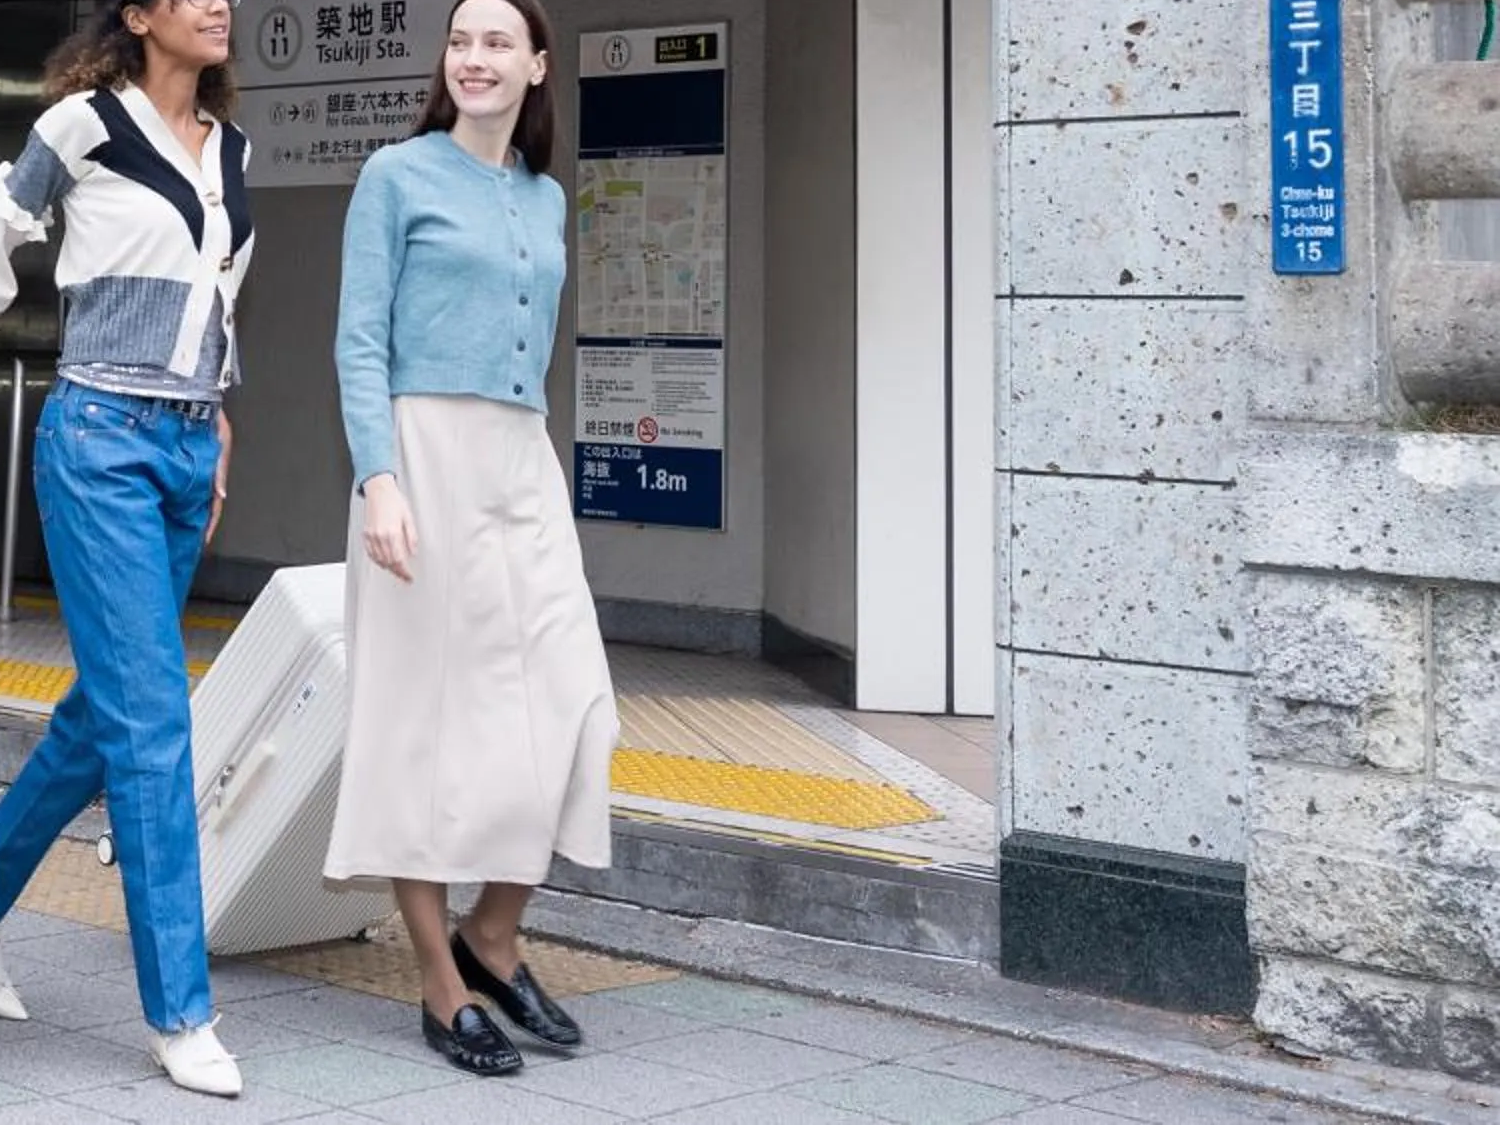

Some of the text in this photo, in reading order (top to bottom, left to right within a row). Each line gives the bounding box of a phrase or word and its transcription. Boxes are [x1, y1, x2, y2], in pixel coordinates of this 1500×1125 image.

[273, 15, 287, 35] H
[315, 0, 407, 40] 築地駅
[270, 36, 289, 58] 11
[315, 38, 411, 67] Tsukiji Sta.
[696, 35, 706, 59] 1
[1283, 128, 1333, 169] 15
[1280, 204, 1335, 222] Tsukiji
[1295, 241, 1323, 263] 15
[636, 463, 688, 492] 1.8m
